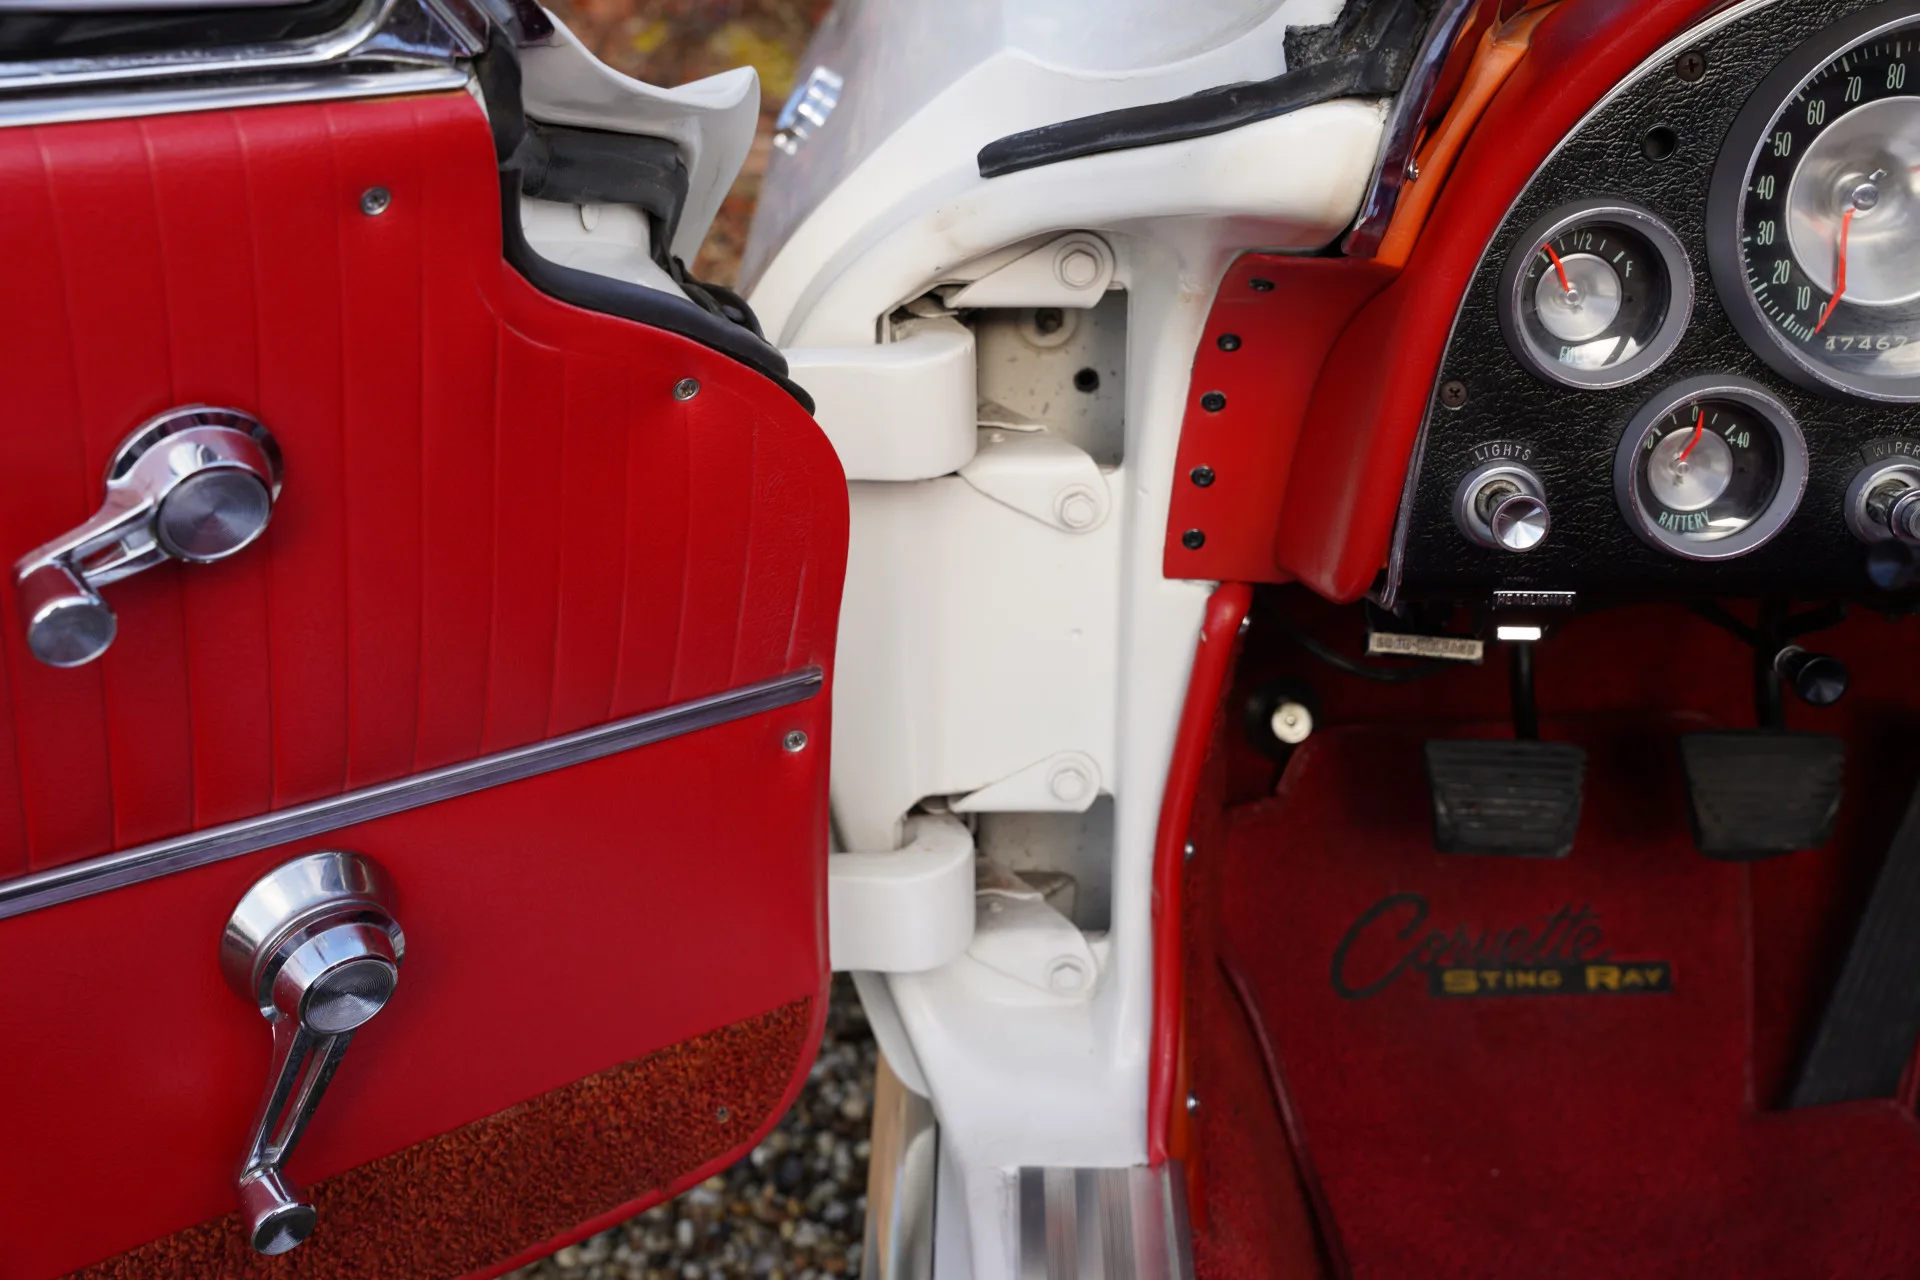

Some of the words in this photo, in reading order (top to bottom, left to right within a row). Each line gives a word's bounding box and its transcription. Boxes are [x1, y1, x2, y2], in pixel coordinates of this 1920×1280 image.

[1844, 76, 1862, 102] 70
[1886, 63, 1906, 90] 80
[1807, 100, 1825, 126] 60
[1773, 131, 1792, 157] 50
[1756, 175, 1775, 200] 40
[1573, 231, 1593, 250] 1/2
[1757, 220, 1775, 246] 30
[1625, 260, 1633, 278] F
[1772, 259, 1790, 285] 20
[1796, 286, 1811, 311] 10
[1475, 443, 1533, 461] LIGHTS
[1727, 431, 1751, 449] +40
[1658, 509, 1711, 532] BATTERY
[1330, 891, 1616, 1001] Corvette
